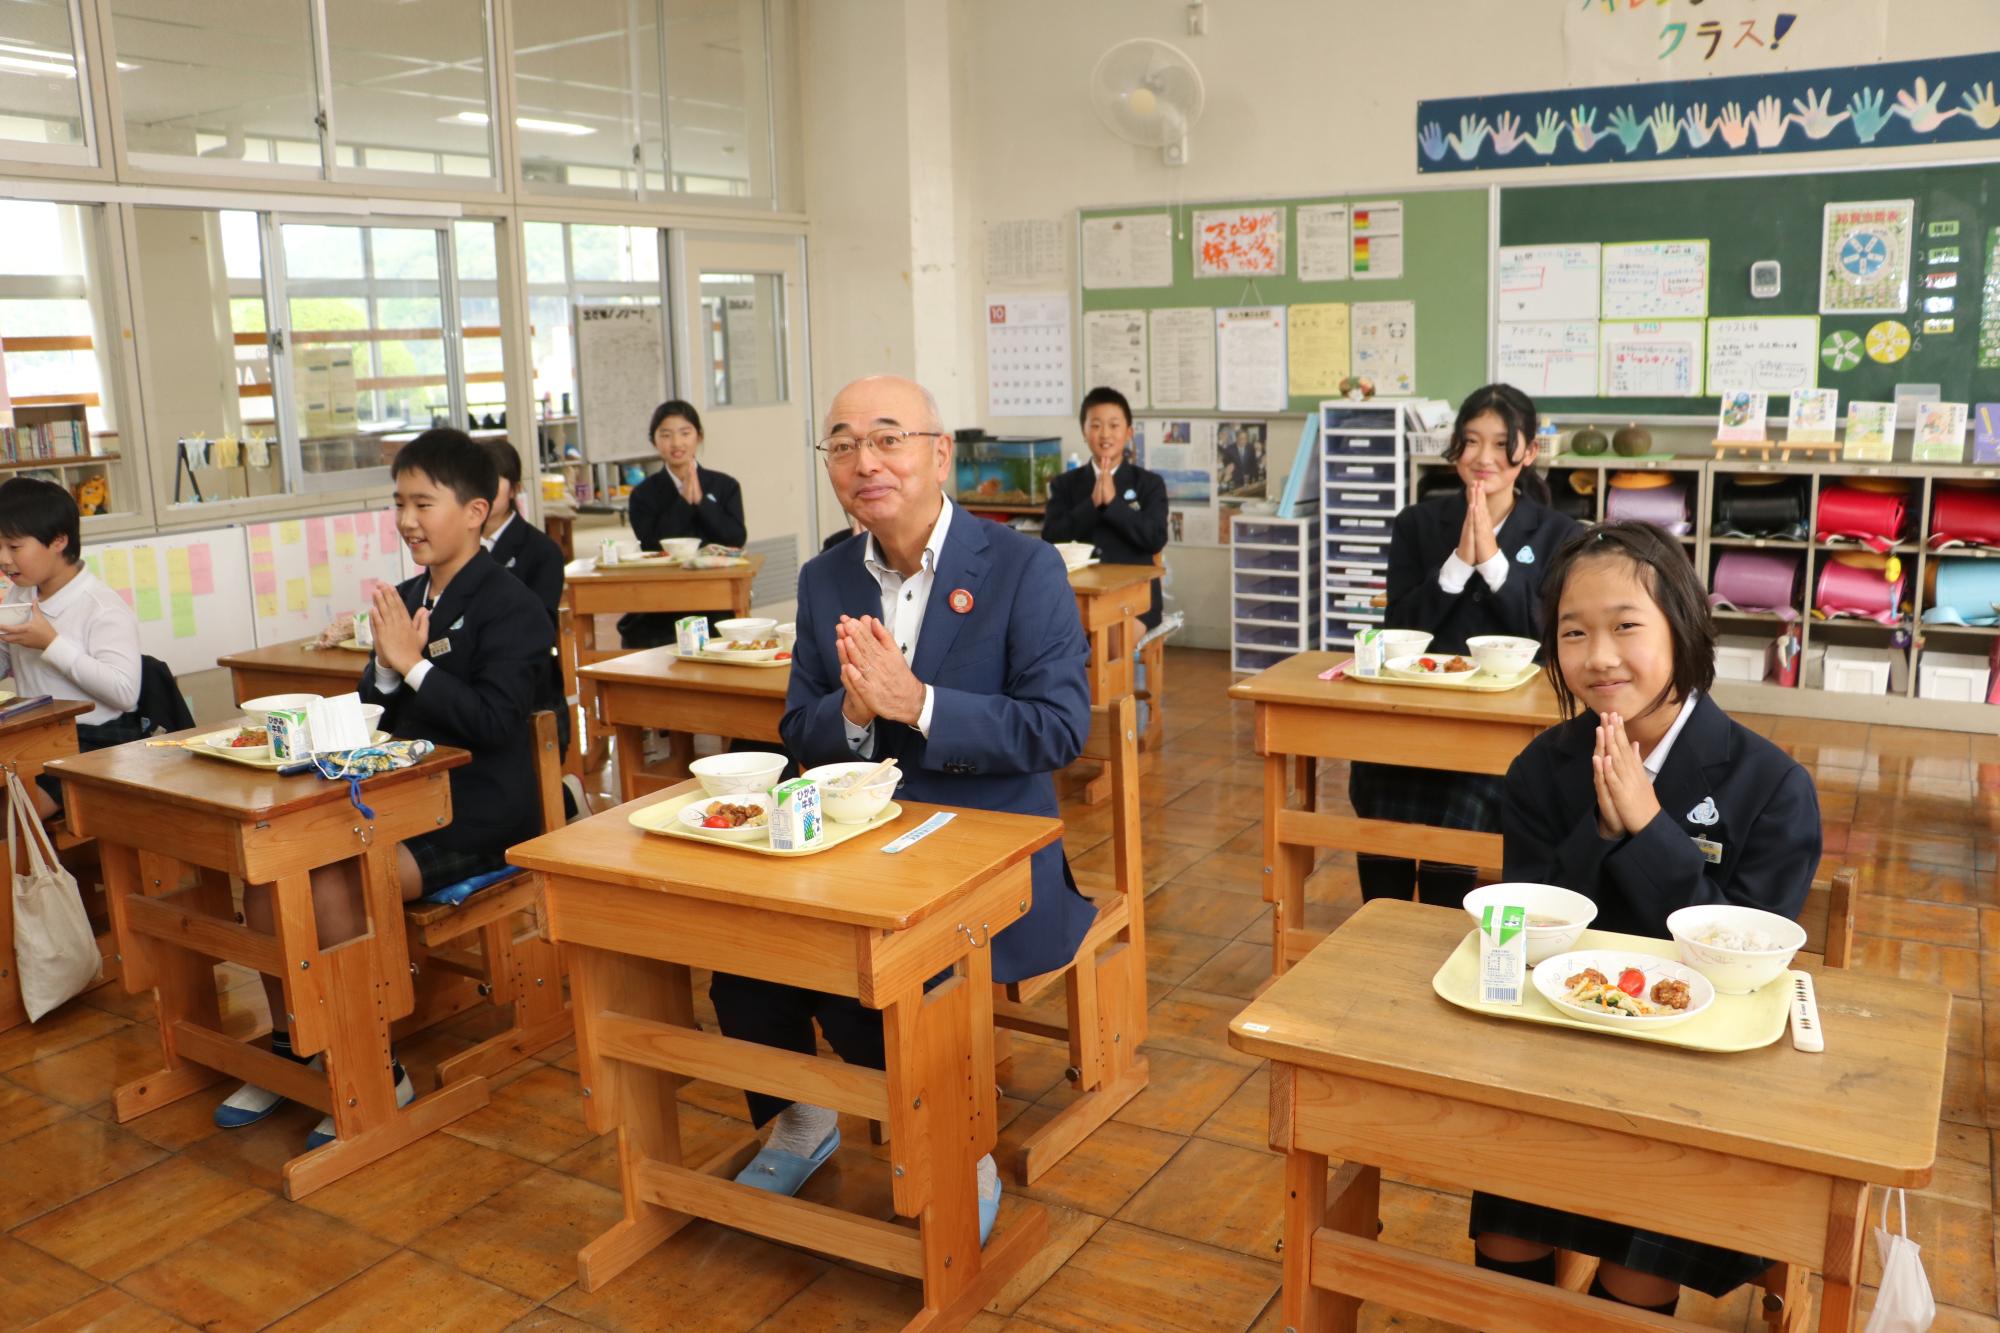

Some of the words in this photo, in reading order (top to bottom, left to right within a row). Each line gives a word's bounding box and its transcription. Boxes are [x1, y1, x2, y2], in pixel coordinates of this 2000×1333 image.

[991, 307, 1003, 318] 10
[796, 785, 816, 801] ひかみ
[801, 796, 814, 809] 牛乳
